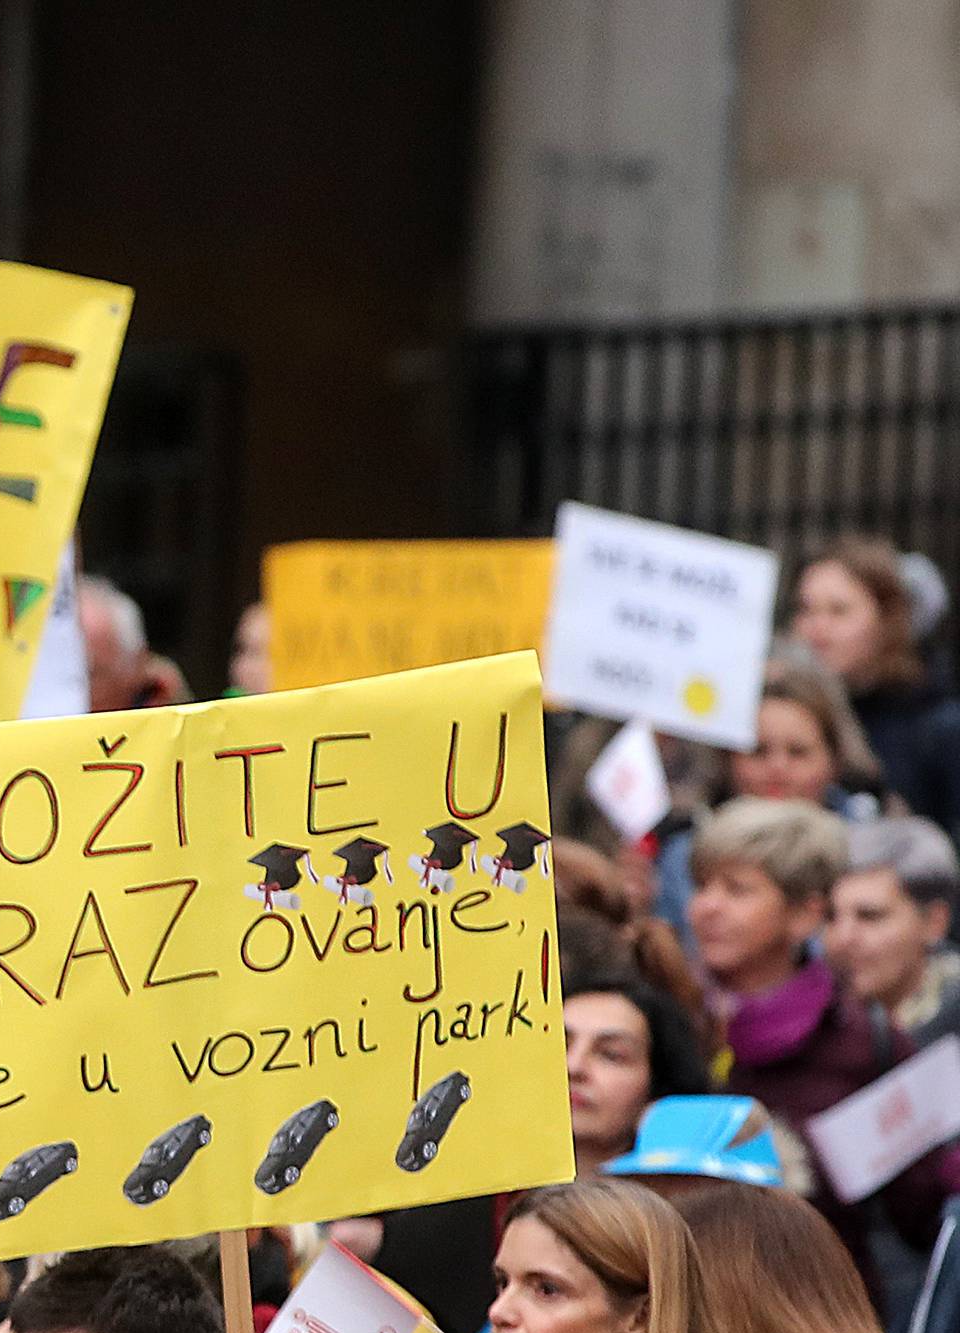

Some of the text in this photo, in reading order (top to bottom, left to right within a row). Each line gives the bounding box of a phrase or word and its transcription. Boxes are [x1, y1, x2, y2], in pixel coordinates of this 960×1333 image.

[444, 713, 509, 821] U
[80, 1052, 120, 1095] u
[170, 998, 378, 1085] vozni
[411, 927, 551, 1104] park!
